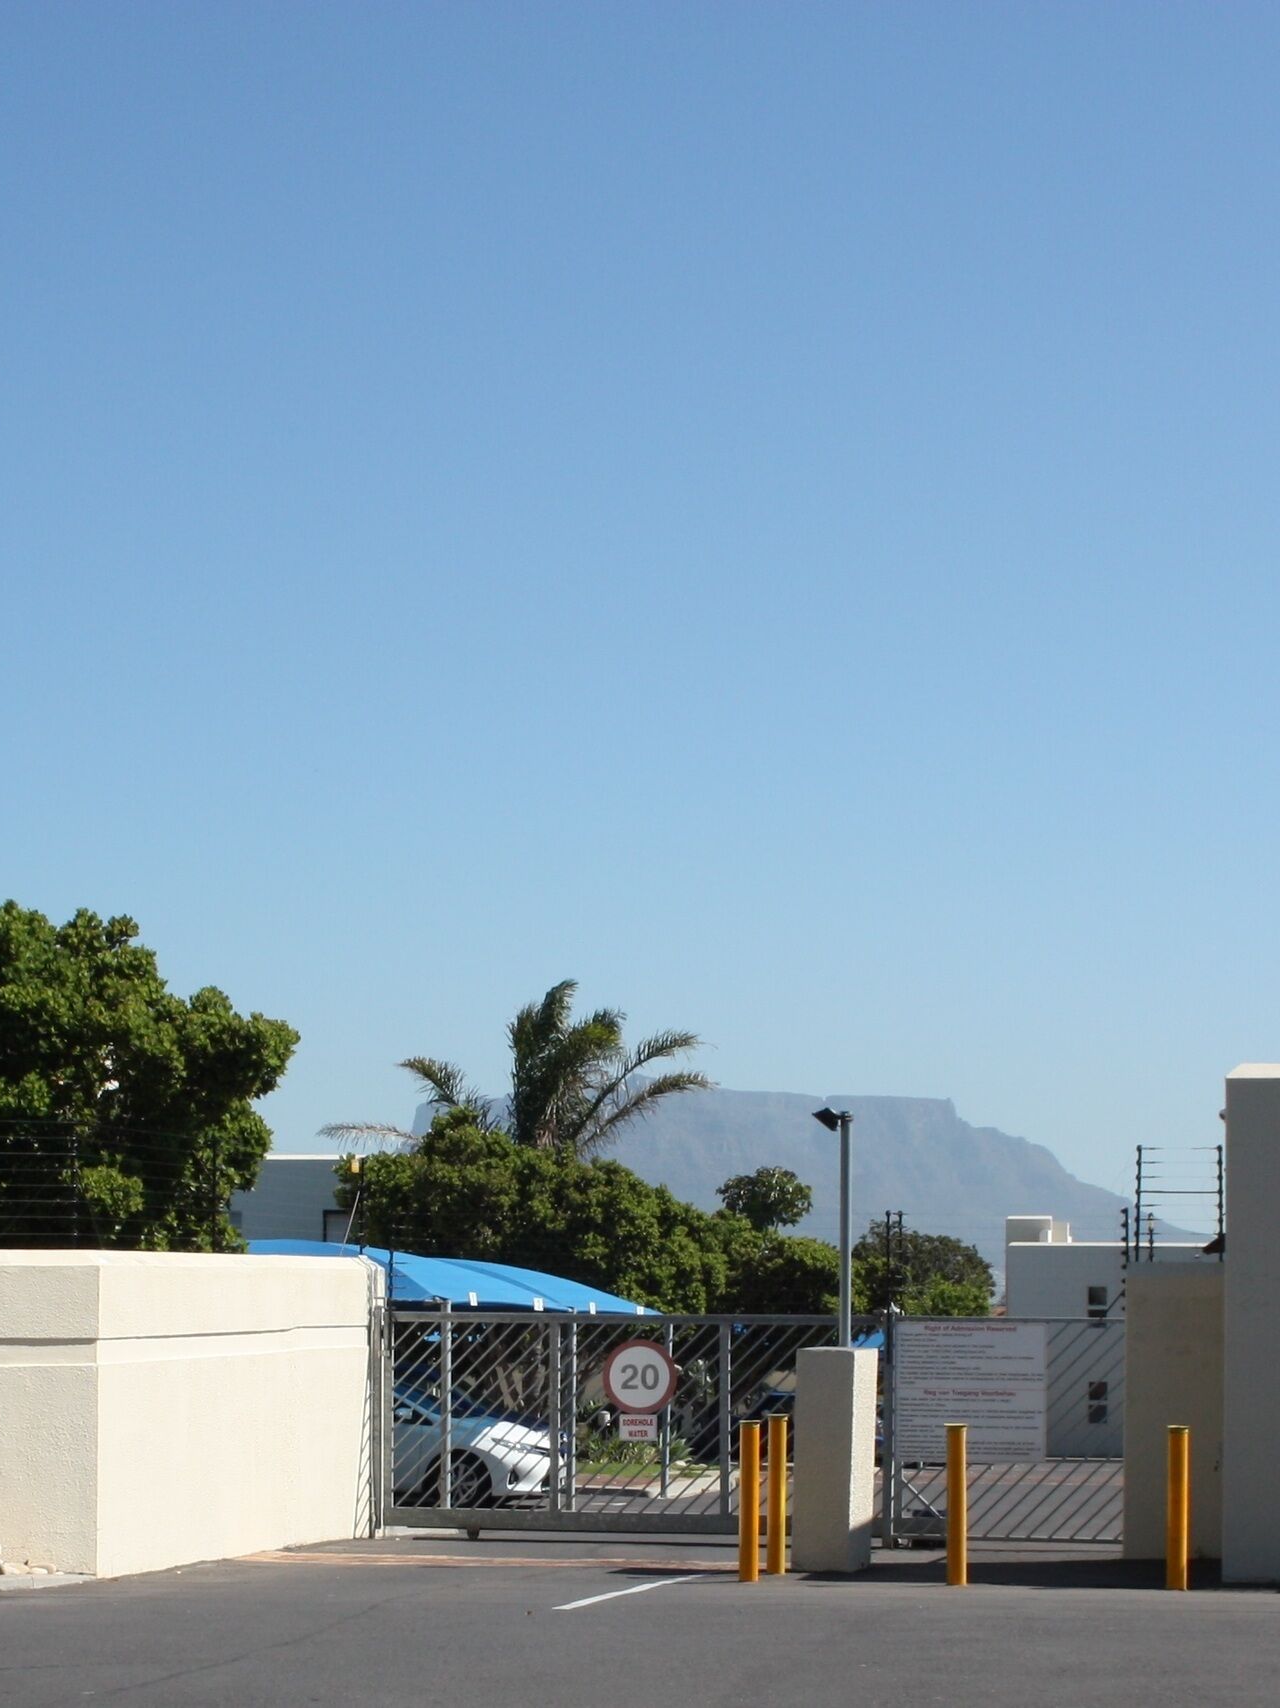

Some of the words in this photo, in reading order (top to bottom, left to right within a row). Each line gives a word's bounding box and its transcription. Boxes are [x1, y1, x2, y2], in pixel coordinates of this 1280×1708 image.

[621, 1363, 659, 1390] 20
[622, 1418, 654, 1427] BOREHOLE
[628, 1430, 648, 1438] WATER
